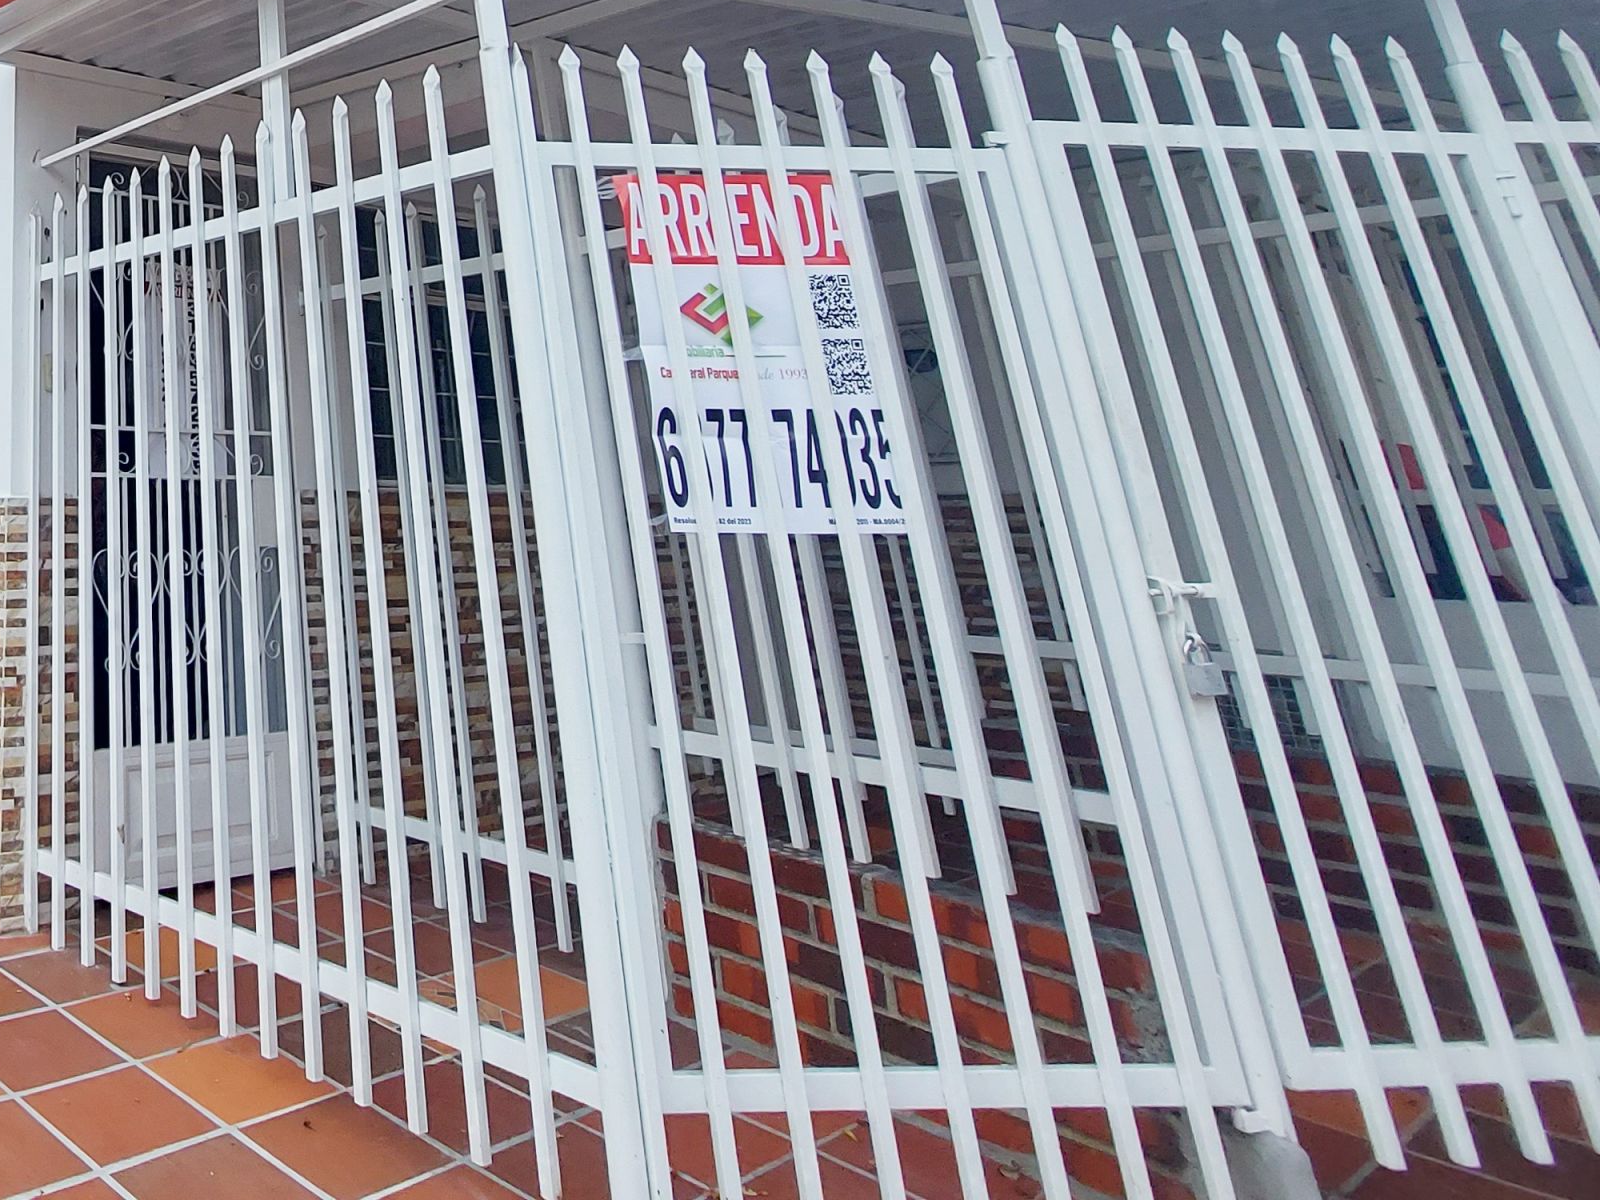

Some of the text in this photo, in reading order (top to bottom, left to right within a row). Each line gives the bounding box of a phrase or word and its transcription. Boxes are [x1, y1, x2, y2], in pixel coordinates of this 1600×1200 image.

[626, 181, 849, 257] ARRENDA
[707, 367, 739, 382] Parque
[778, 367, 808, 380] 1993
